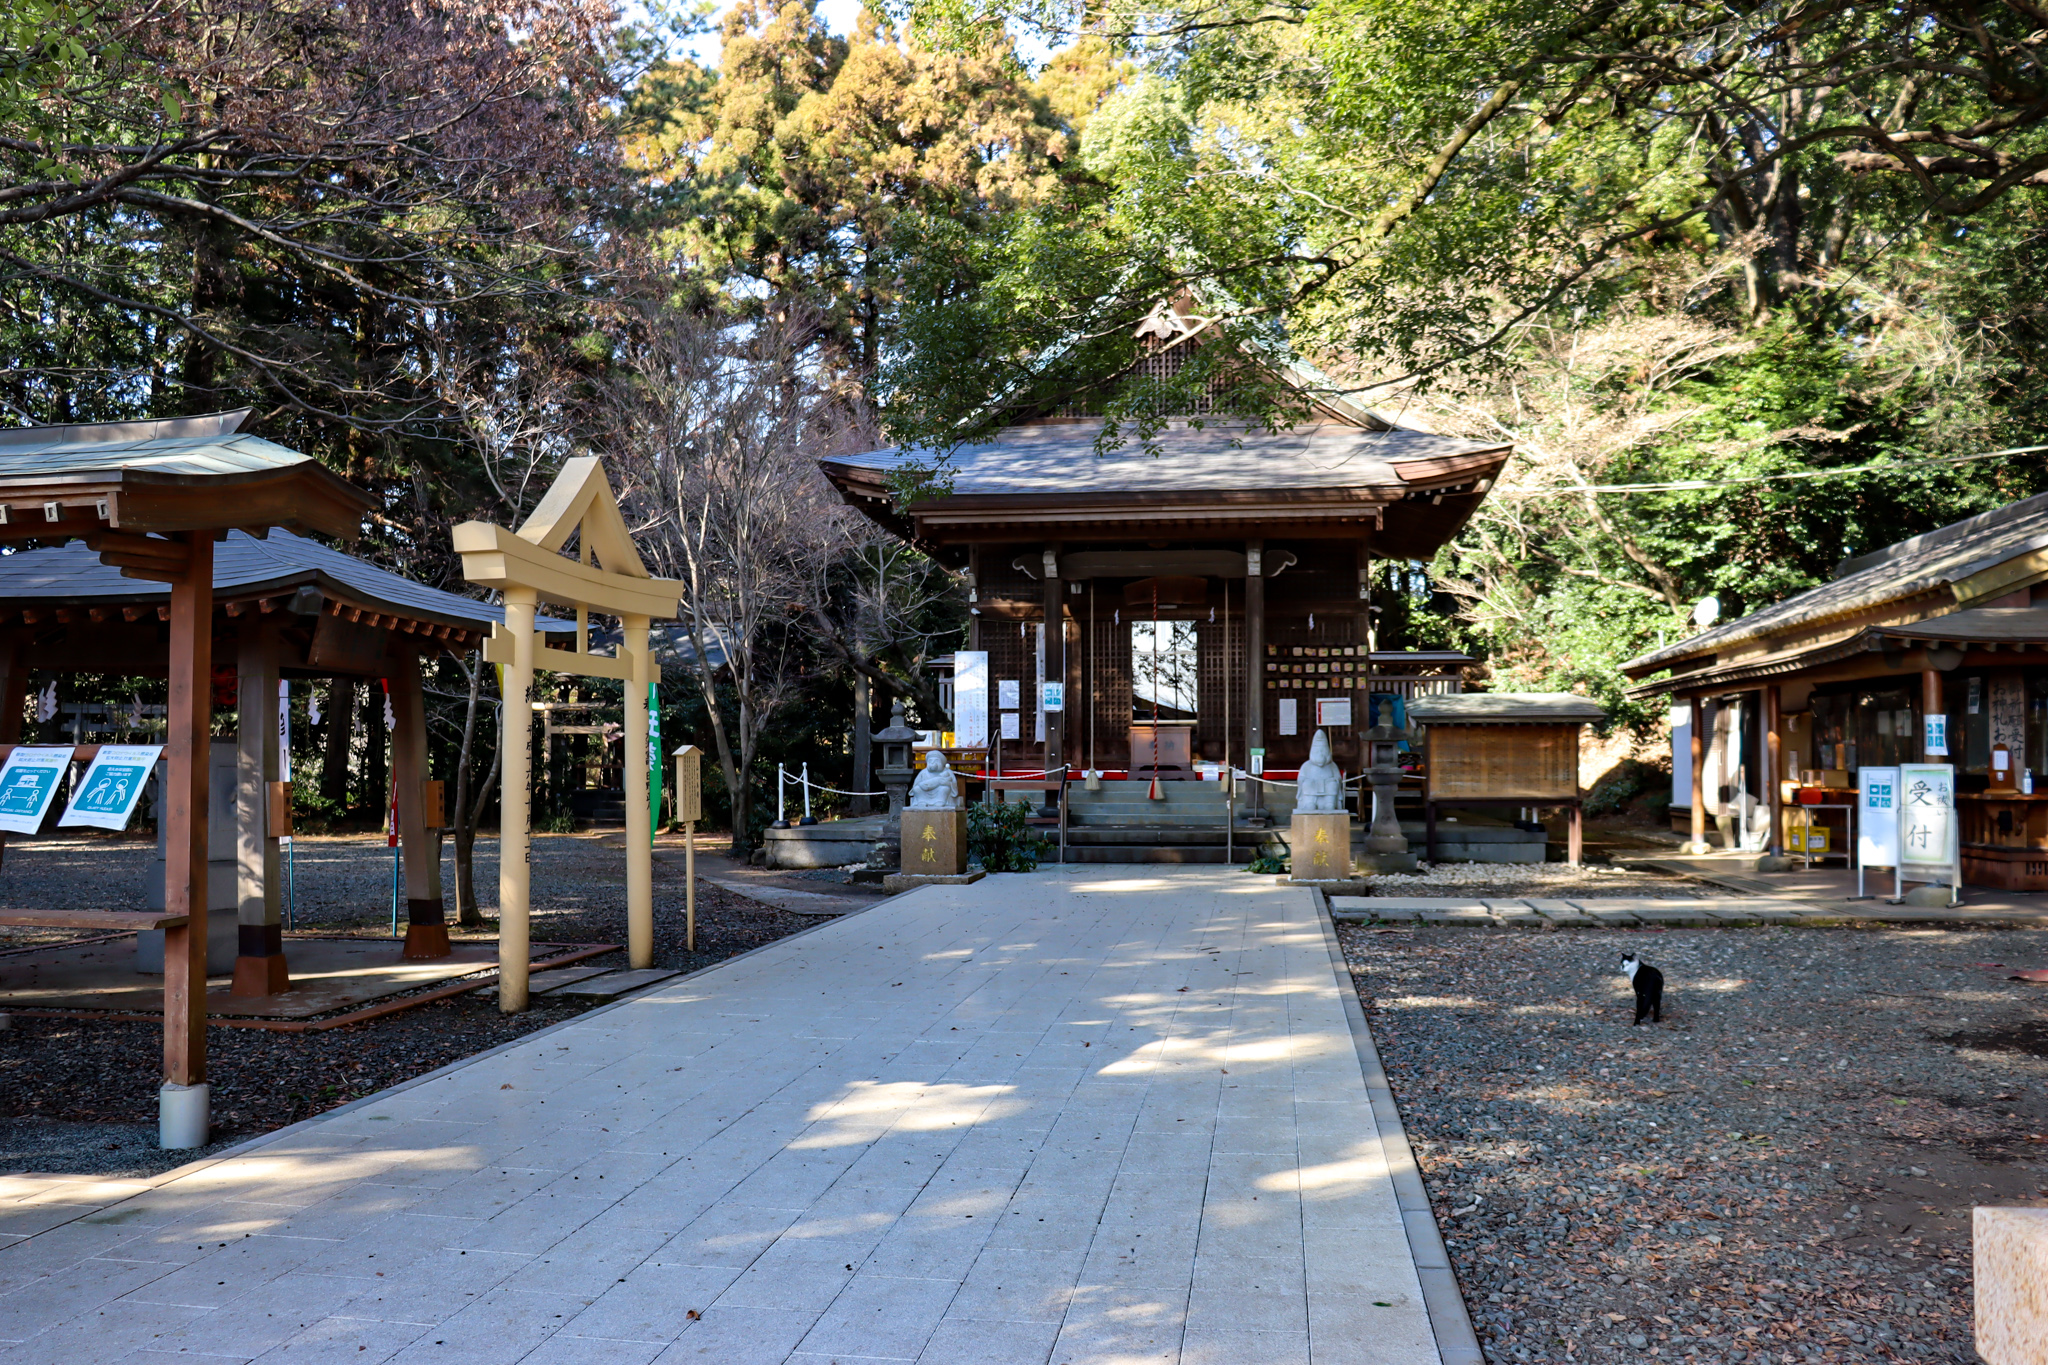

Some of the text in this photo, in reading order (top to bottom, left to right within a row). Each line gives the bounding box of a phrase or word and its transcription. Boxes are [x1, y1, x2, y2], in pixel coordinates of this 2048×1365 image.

[1907, 780, 1933, 849] 受付
[921, 824, 937, 863] 奉献
[1313, 827, 1330, 867] 奉献
